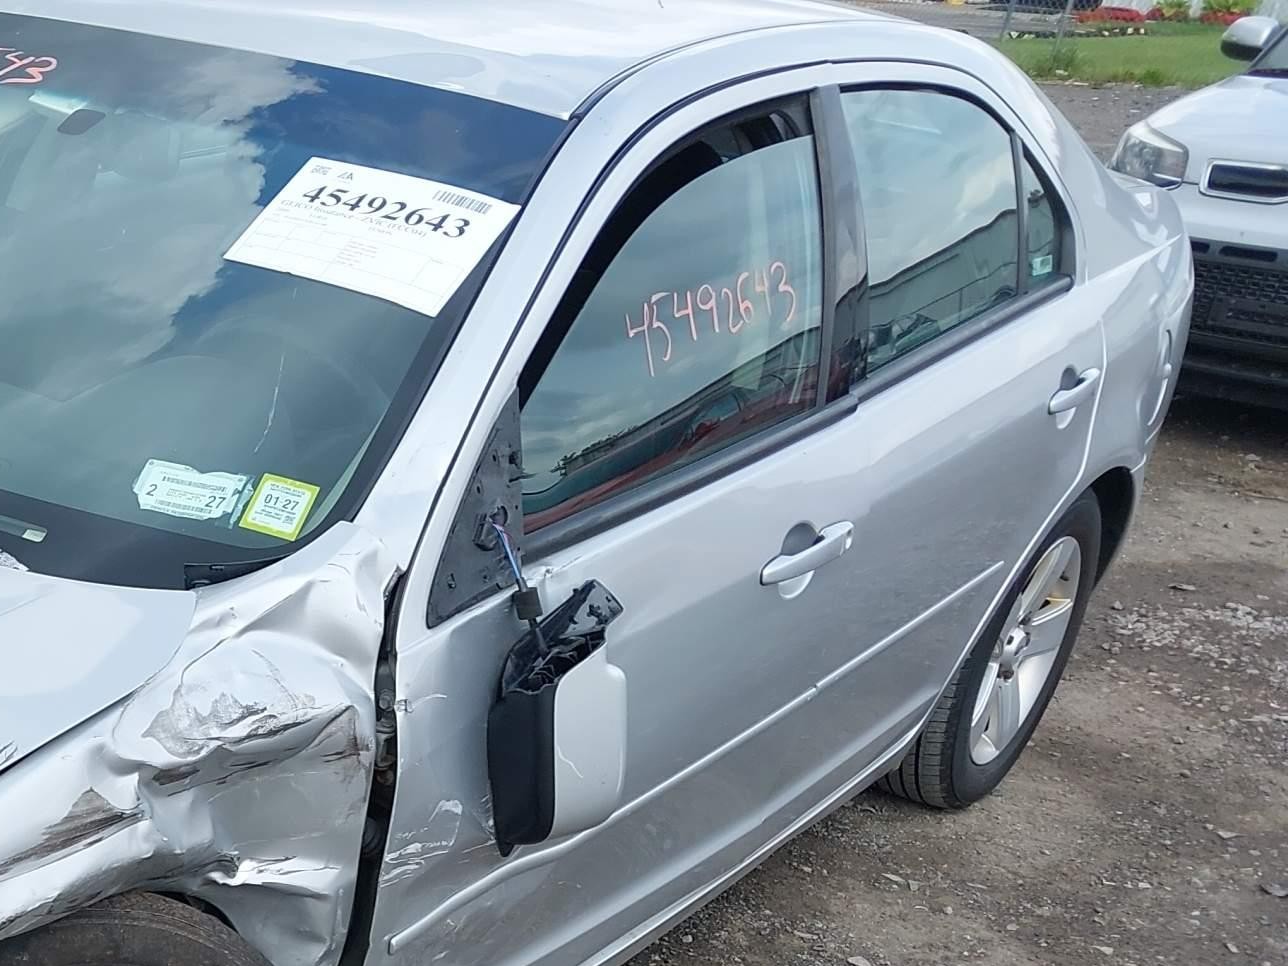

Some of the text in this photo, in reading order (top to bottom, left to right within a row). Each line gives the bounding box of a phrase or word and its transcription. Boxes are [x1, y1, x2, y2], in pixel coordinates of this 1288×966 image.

[302, 185, 471, 239] 45492643
[625, 261, 797, 378] 45492643
[145, 483, 158, 497] 2
[204, 495, 227, 509] 27
